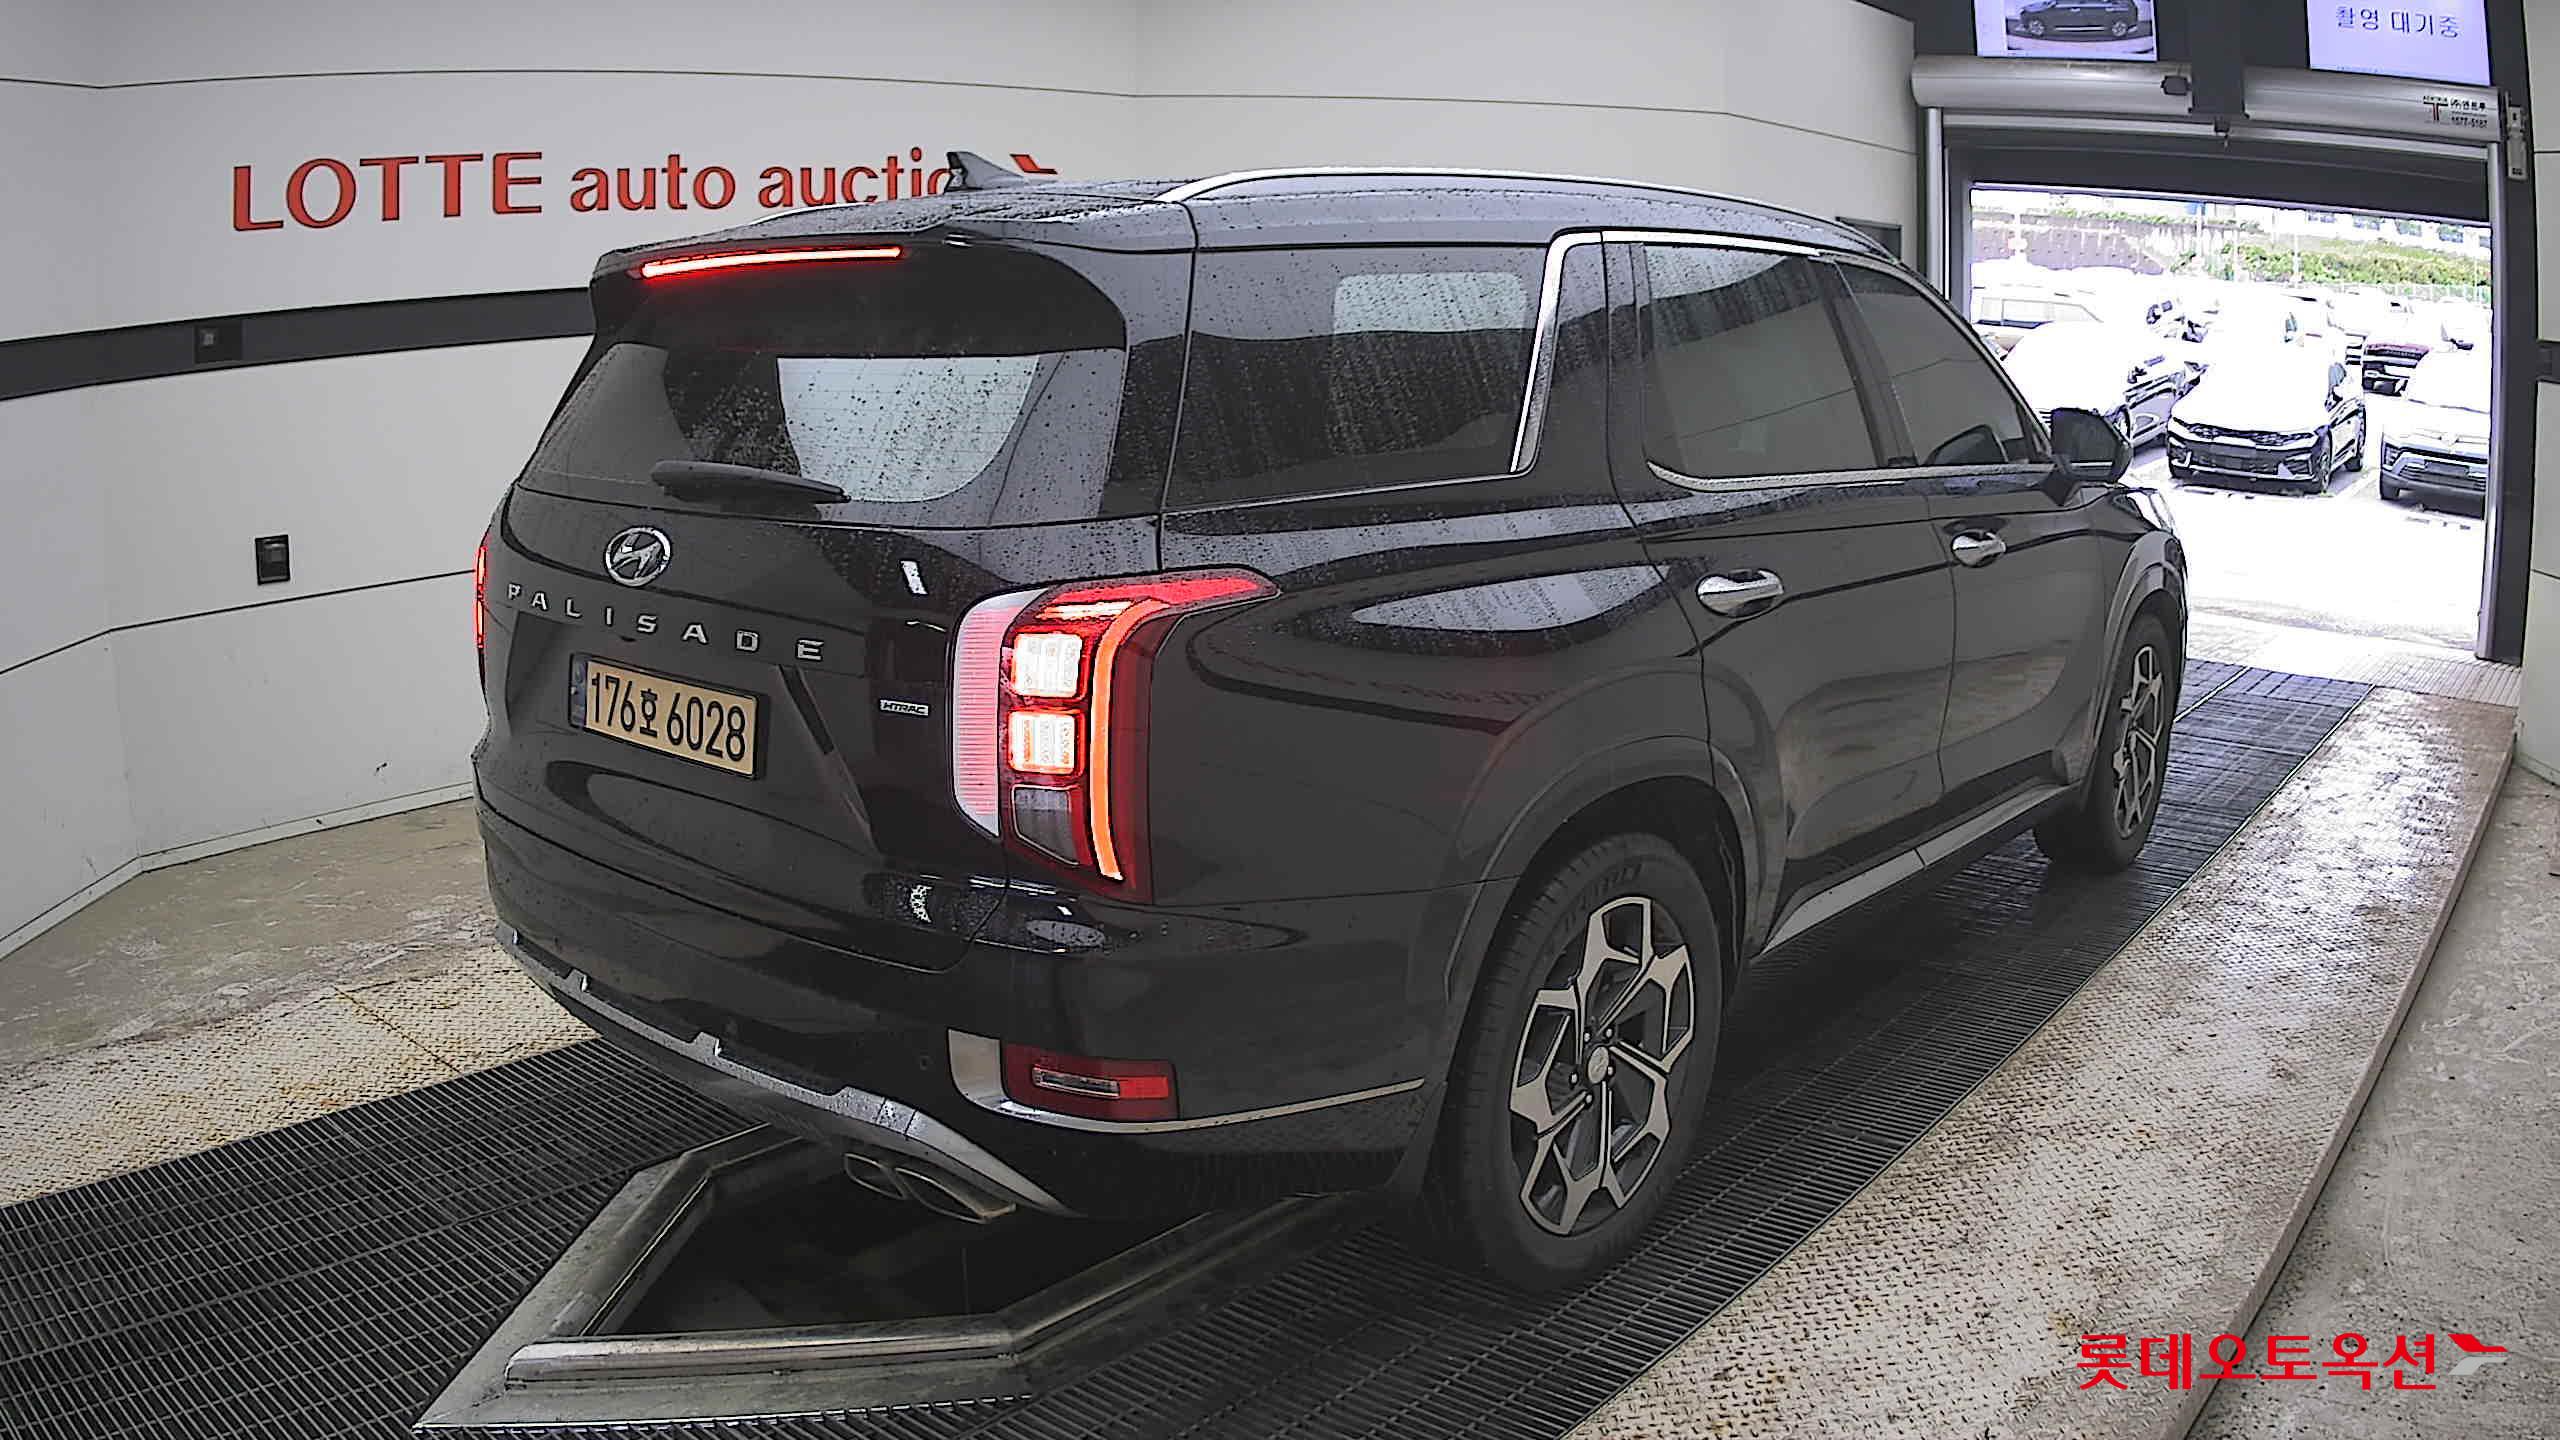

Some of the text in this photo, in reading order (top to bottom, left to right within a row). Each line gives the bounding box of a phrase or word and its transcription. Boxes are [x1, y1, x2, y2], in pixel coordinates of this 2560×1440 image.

[2391, 11, 2458, 39] 대기중
[233, 146, 951, 232] LOTTE auto aucti
[507, 583, 825, 661] PALISADE
[591, 672, 746, 761] 176호 6028
[881, 700, 929, 715] HTRAC
